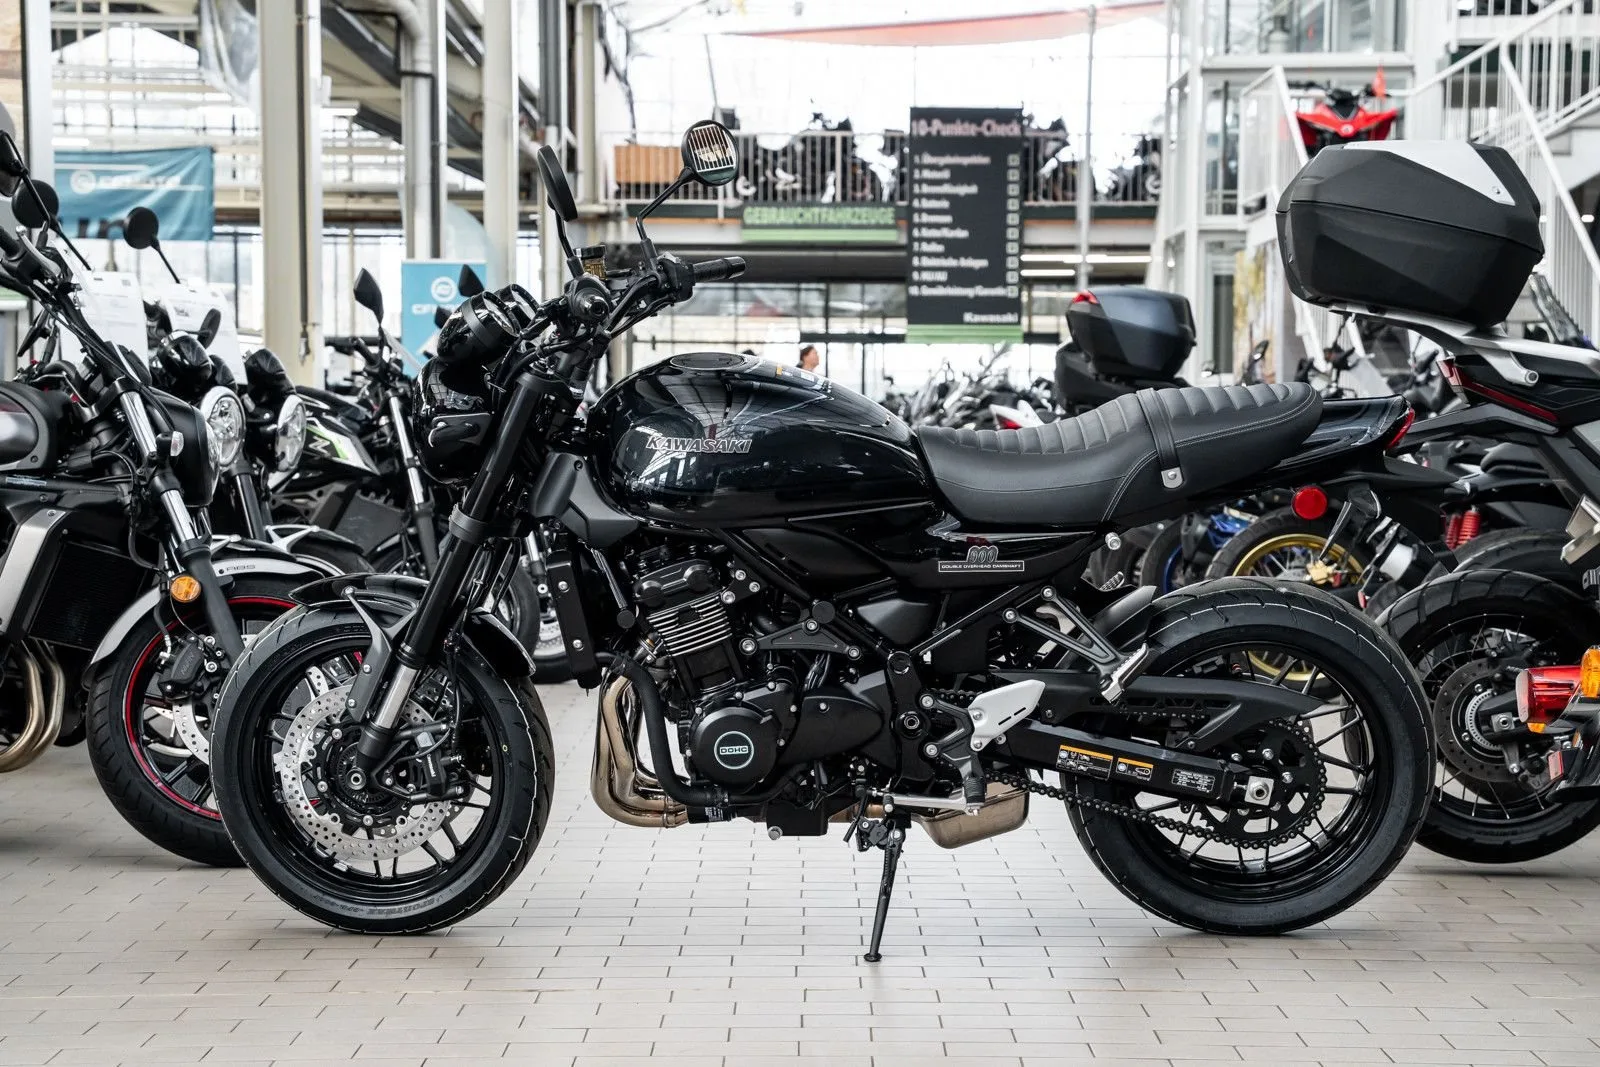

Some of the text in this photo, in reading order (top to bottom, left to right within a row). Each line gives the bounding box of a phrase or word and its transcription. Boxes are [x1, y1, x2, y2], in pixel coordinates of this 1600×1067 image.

[911, 119, 1021, 137] 10-Punkte-Check
[963, 312, 1019, 323] Kawasaki
[646, 436, 752, 453] KAWASAKI
[720, 746, 748, 754] DOHC
